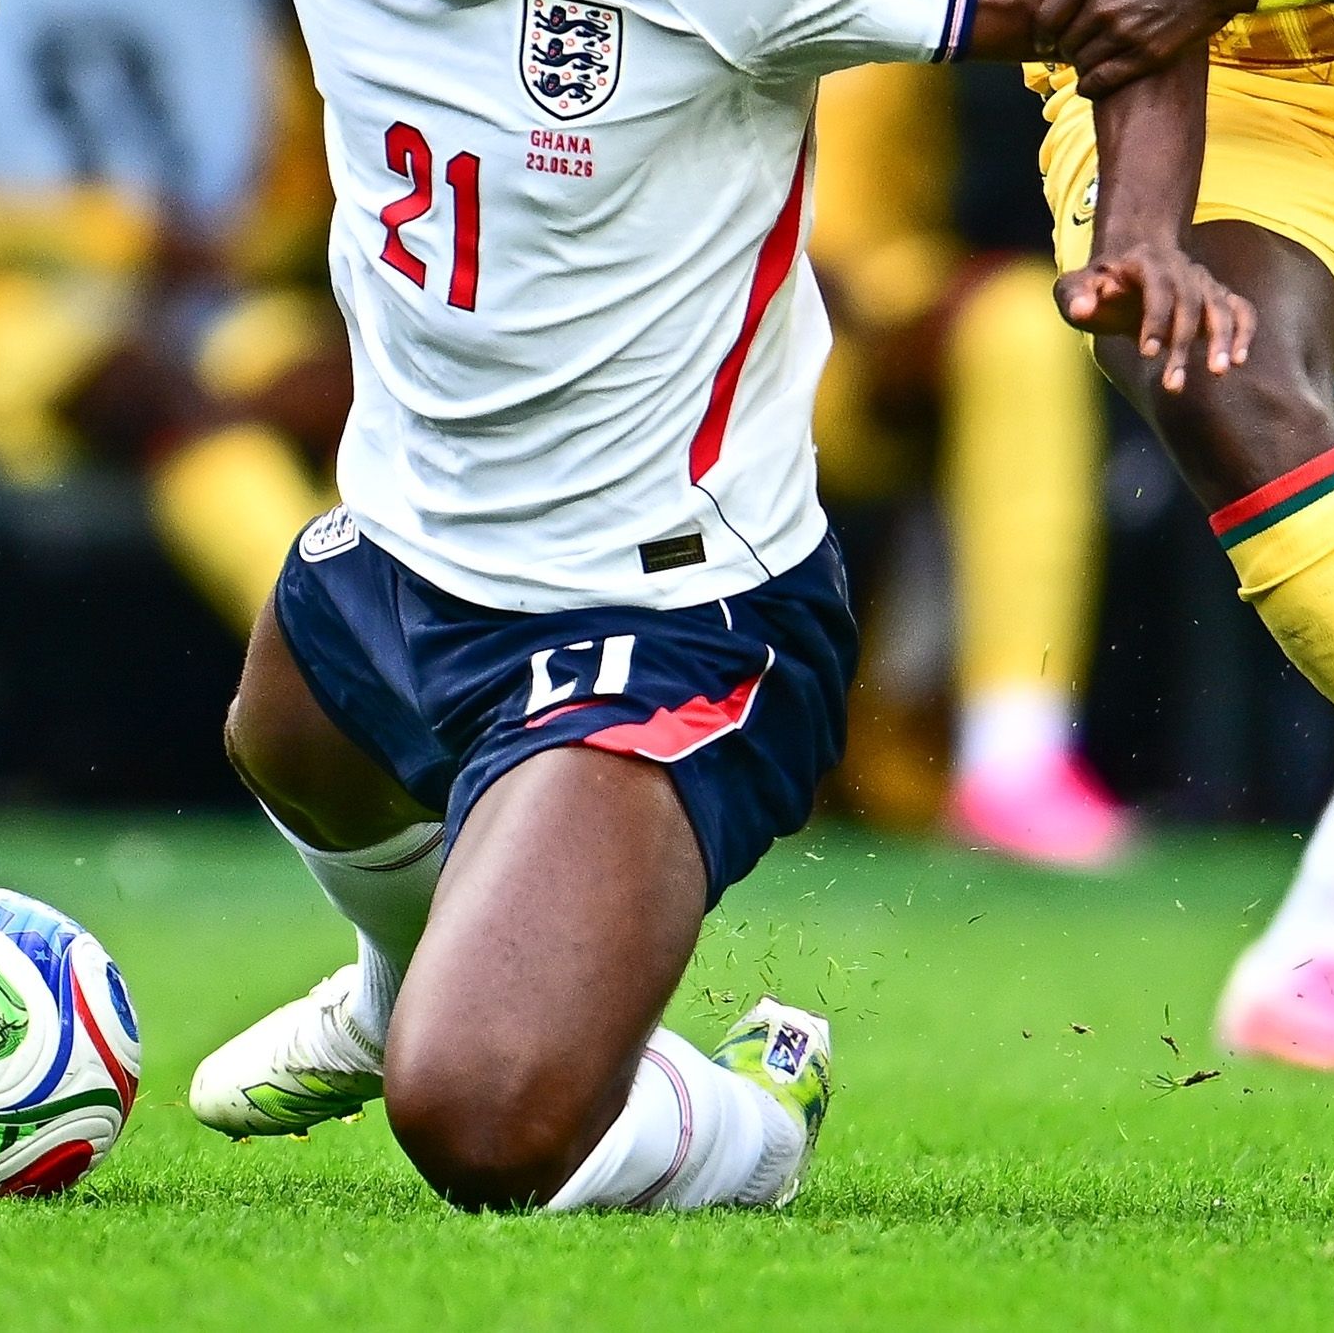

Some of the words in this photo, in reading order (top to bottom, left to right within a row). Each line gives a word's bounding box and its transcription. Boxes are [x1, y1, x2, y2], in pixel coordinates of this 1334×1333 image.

[530, 129, 592, 155] GHANA
[526, 152, 593, 177] 23.06.26
[379, 120, 481, 313] 21
